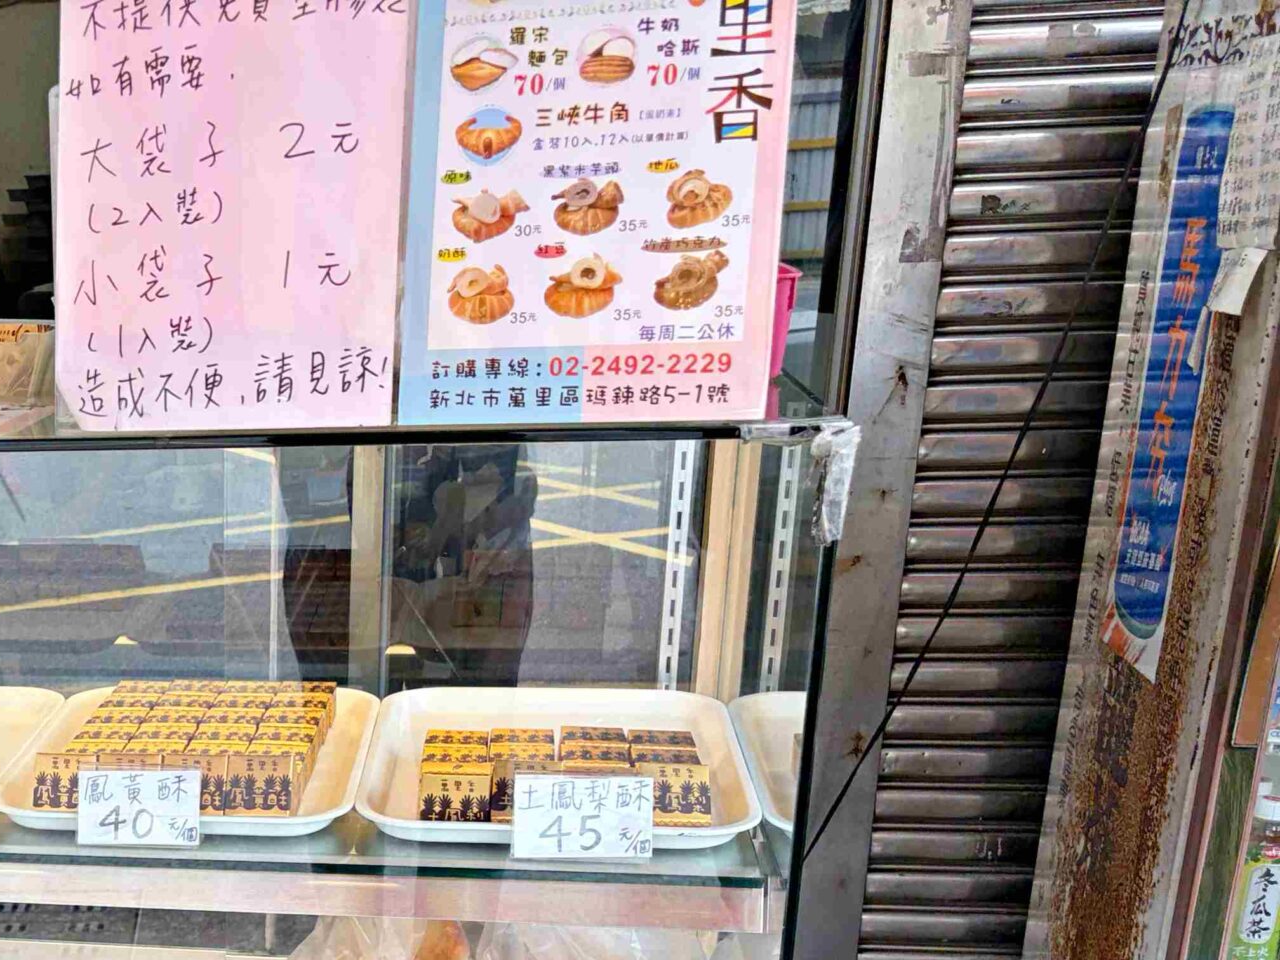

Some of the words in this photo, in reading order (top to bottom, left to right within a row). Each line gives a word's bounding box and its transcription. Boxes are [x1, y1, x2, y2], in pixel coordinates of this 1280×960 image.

[509, 26, 550, 46] 羅宋
[638, 17, 679, 35] 牛奶
[528, 48, 568, 68] 麵包
[657, 38, 700, 56] 哈斯
[536, 102, 629, 128] 三峽牛角
[81, 121, 224, 183] 大袋子
[279, 122, 360, 159] 2元
[648, 159, 679, 172] 地瓜
[443, 171, 472, 185] 原味
[514, 224, 543, 238] 30元
[618, 218, 648, 233] 35元
[721, 214, 751, 228] 35元
[537, 242, 566, 256] 紅豆
[74, 245, 223, 306] 小袋子
[282, 250, 351, 289] 1元
[509, 312, 537, 325] 35元
[613, 309, 642, 322] 35元
[714, 304, 744, 318] 35元
[638, 323, 735, 342] 每周二公休
[84, 773, 189, 806] 鳳黃酥
[517, 779, 652, 812] 土鳳梨酥
[98, 805, 154, 841] 40
[539, 814, 603, 853] 45
[1245, 867, 1279, 939] 冬瓜茶
